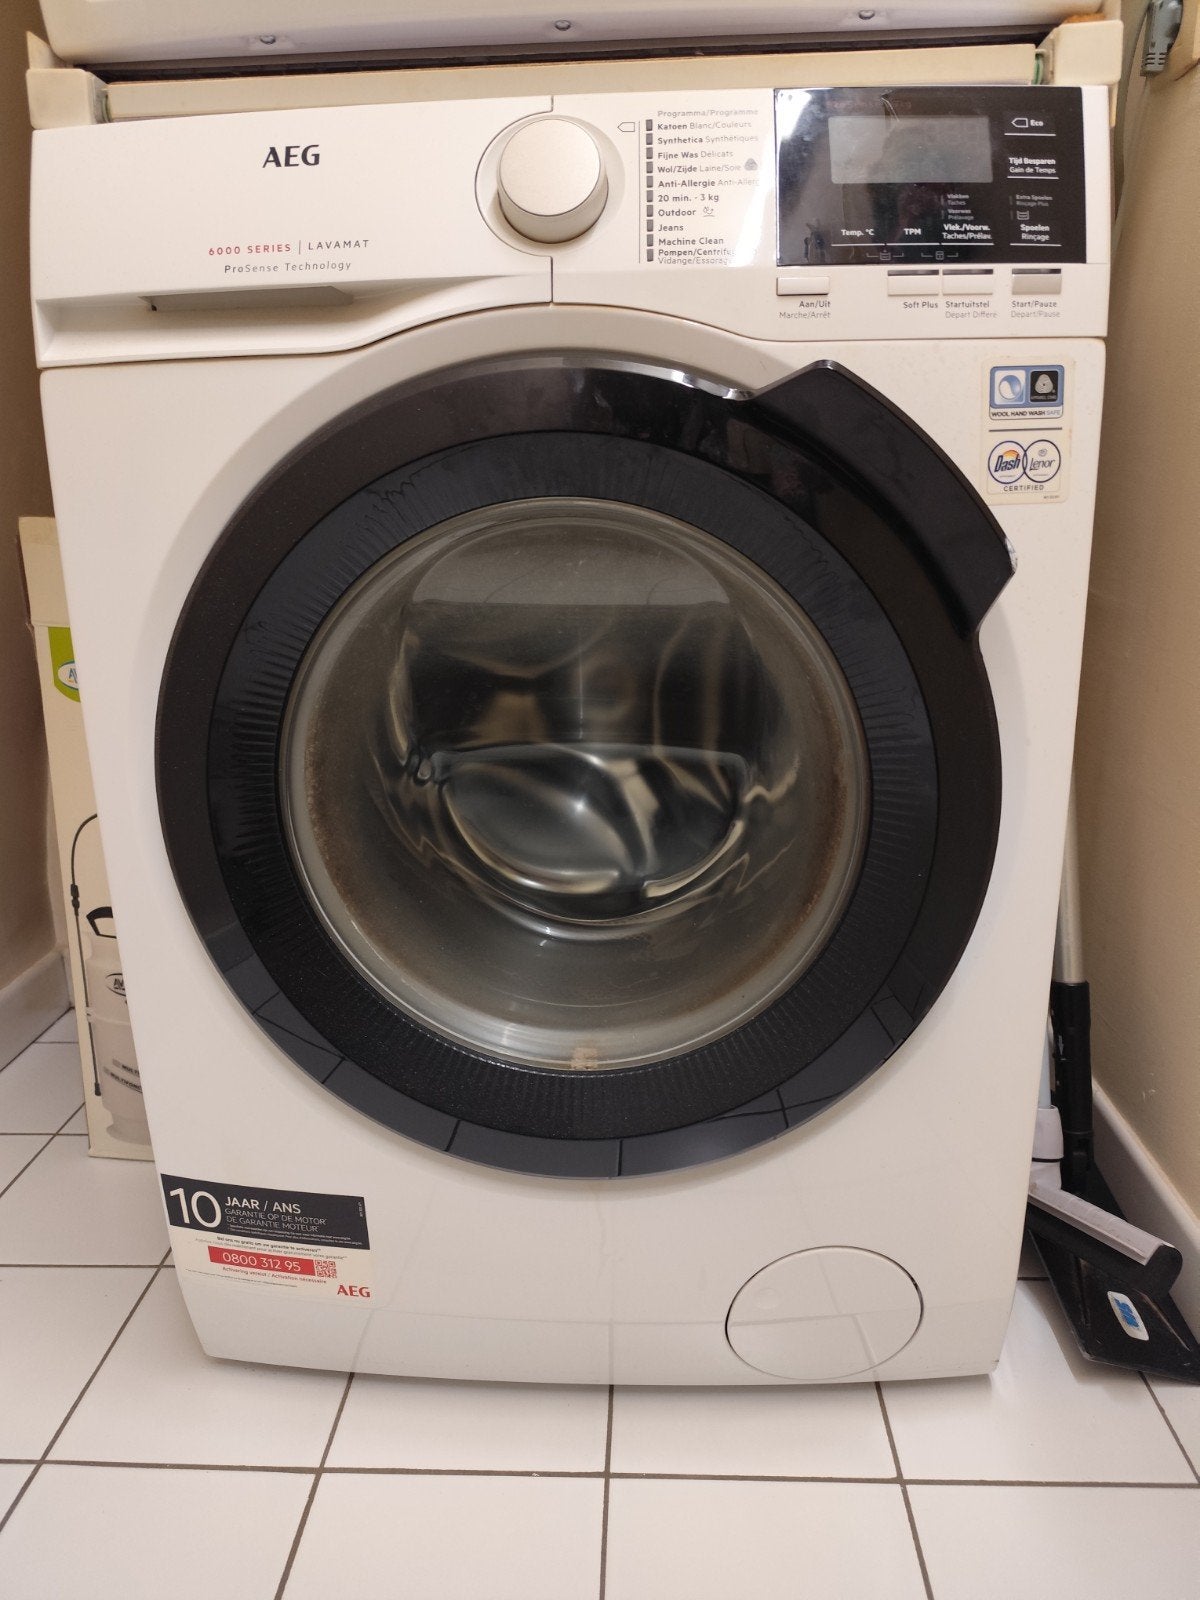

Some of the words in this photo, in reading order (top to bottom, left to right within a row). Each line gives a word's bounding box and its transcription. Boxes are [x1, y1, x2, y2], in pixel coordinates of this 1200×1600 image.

[689, 121, 752, 129] Blanc/Couleurs
[1030, 119, 1043, 127] Eco
[657, 137, 703, 145] Synthetica
[262, 144, 321, 168] AEG
[657, 152, 679, 160] Fijne
[1009, 157, 1023, 166] Tijd
[1023, 158, 1056, 166] Besparen
[657, 165, 698, 174] Wol/Zijde
[699, 164, 741, 172] Laine/Soie
[1035, 167, 1056, 175] Temps
[658, 179, 716, 188] Anti-Allergie
[657, 194, 669, 202] 20
[672, 194, 692, 202] min.
[708, 194, 719, 203] kg
[658, 208, 697, 217] Outdoor
[658, 224, 684, 232] Jeans
[841, 229, 864, 237] Temp.
[865, 228, 874, 236] °C
[904, 228, 922, 236] TPM
[1020, 224, 1050, 232] Spoelen
[1021, 232, 1050, 241] Rinçage
[658, 238, 696, 246] Machine
[699, 237, 724, 245] Clean
[208, 246, 241, 256] 6000
[247, 243, 291, 254] SERIES
[308, 239, 369, 251] LAVAMAT
[224, 263, 279, 274] ProSense
[285, 261, 352, 272] Technology
[799, 300, 831, 309] Aan/Uit
[903, 300, 920, 309] Soft
[921, 300, 939, 309] Plus
[945, 300, 990, 308] Startuitstel
[1011, 300, 1058, 309] Start/Pauze
[994, 454, 1021, 472] Dash
[1029, 457, 1056, 471] Lenor
[1003, 484, 1045, 492] CERTIFIED
[169, 1187, 223, 1229] 10
[224, 1196, 260, 1210] JAAR
[263, 1200, 268, 1211] /
[272, 1201, 301, 1214] ANS
[224, 1208, 267, 1221] GARANTIE
[267, 1212, 280, 1221] OP
[281, 1213, 293, 1222] DE
[226, 1216, 237, 1224] DE
[238, 1217, 280, 1228] GARANTIE
[222, 1252, 257, 1267] 0800
[260, 1256, 281, 1270] 312
[284, 1259, 301, 1272] 95
[337, 1284, 371, 1298] AEG
